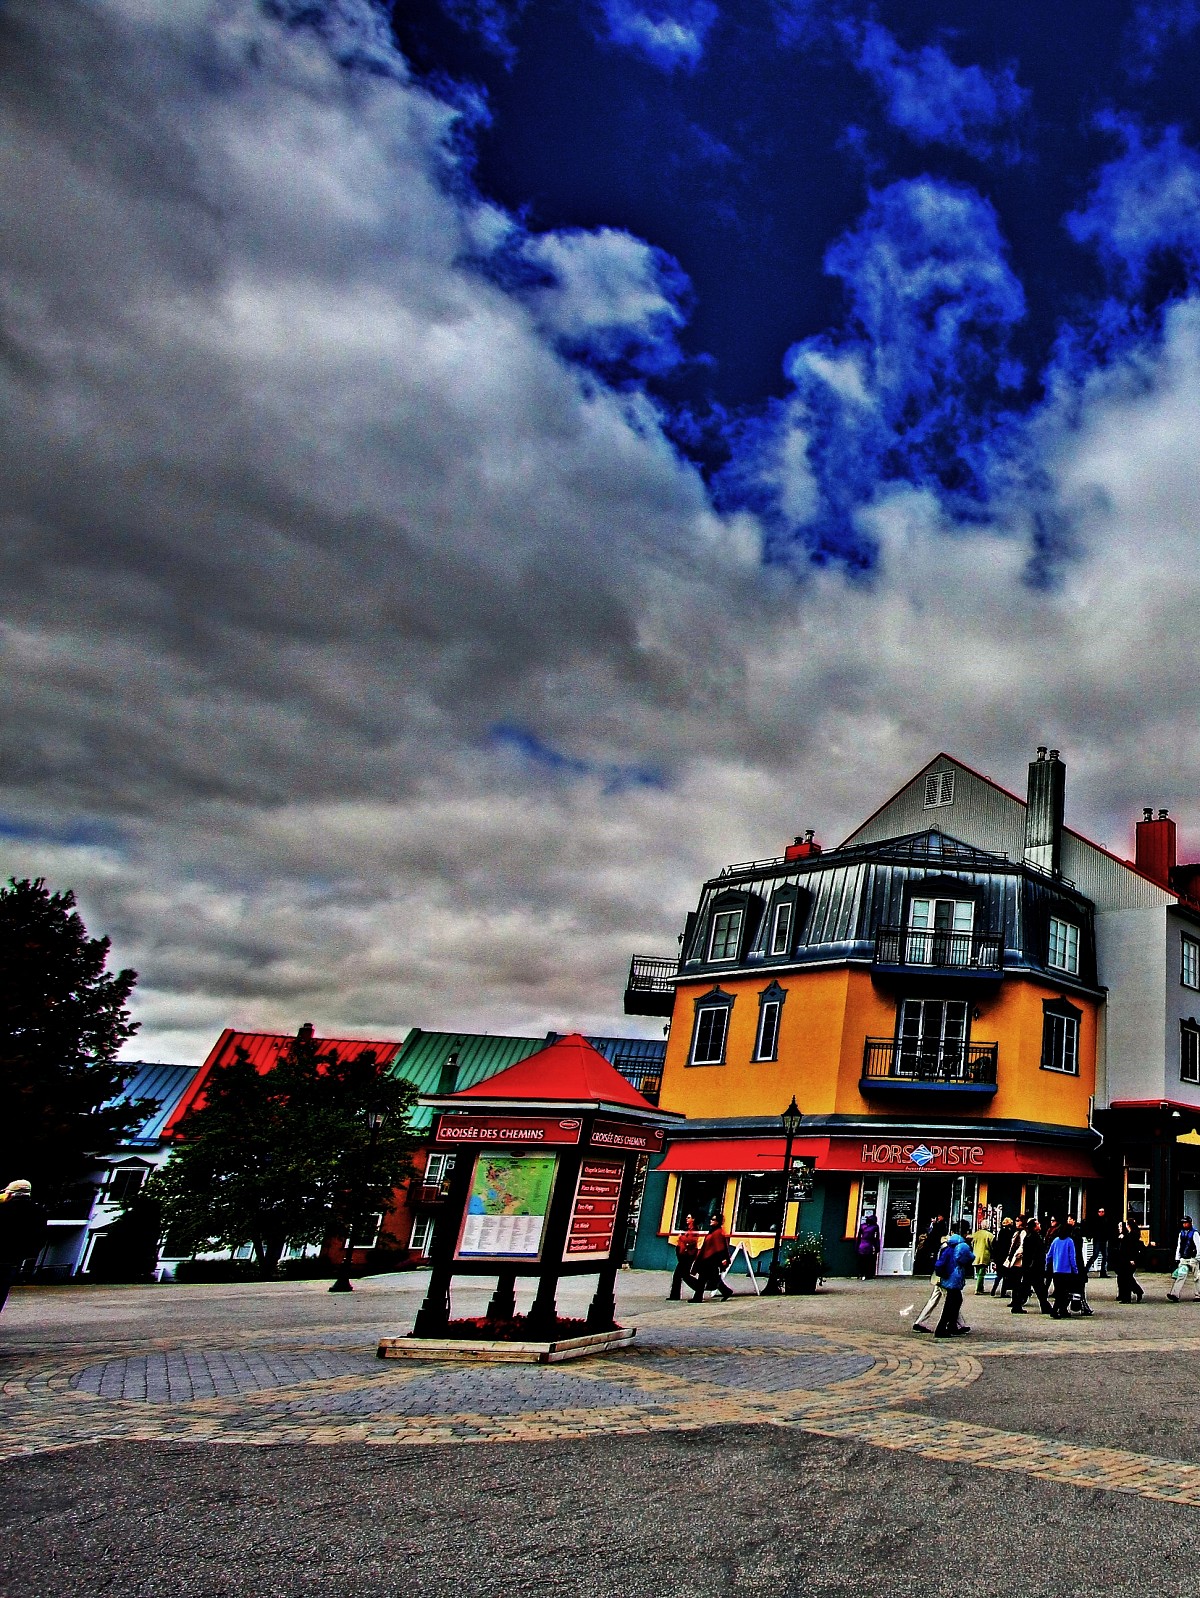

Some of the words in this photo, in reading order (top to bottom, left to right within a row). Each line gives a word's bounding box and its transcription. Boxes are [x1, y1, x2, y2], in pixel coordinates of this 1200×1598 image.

[440, 1127, 479, 1138] CROISÉE
[480, 1129, 498, 1139] DES
[499, 1129, 544, 1140] CHEMINS
[592, 1132, 614, 1143] CROISÉE
[613, 1134, 624, 1144] DES
[624, 1136, 646, 1147] CHEMINS
[862, 1144, 914, 1163] HORS
[930, 1145, 984, 1165] PISTE
